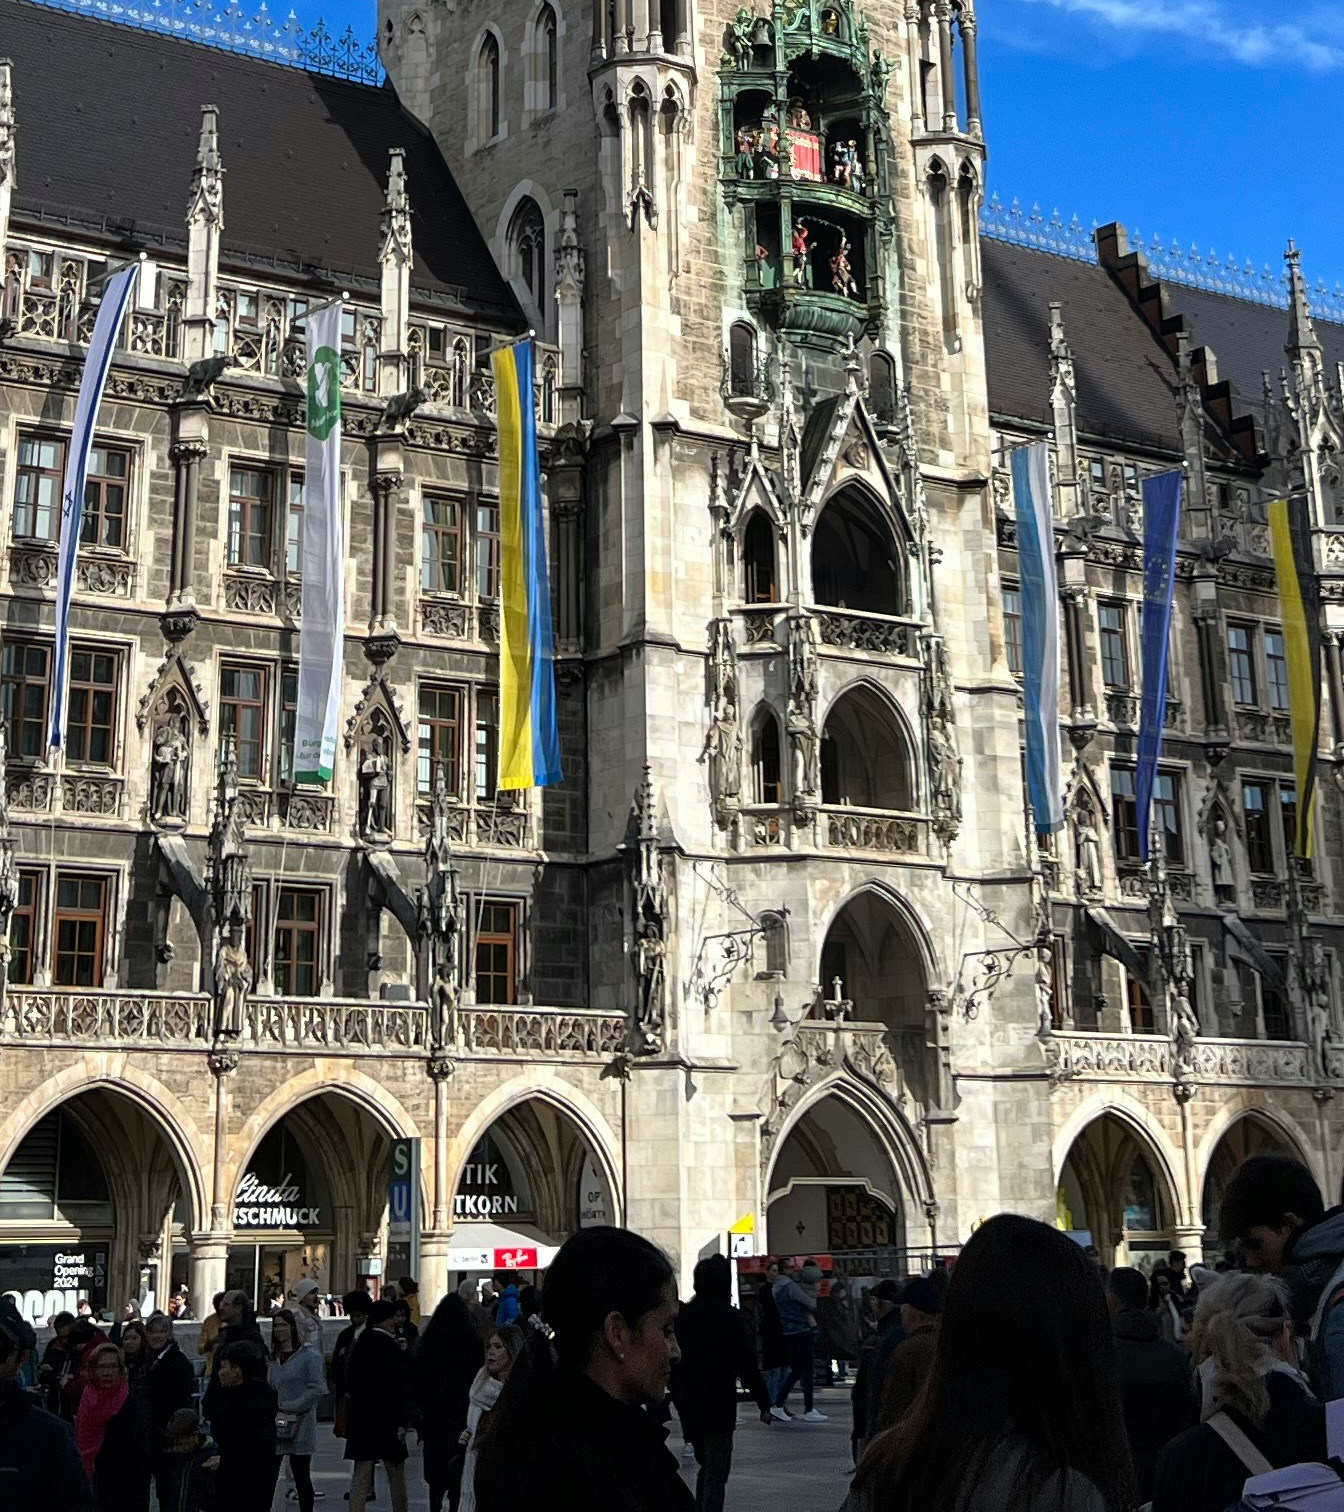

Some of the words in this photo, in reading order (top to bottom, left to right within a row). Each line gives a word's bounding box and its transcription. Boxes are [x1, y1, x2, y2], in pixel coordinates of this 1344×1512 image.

[394, 1143, 409, 1176] S
[465, 1163, 498, 1185] TIK
[235, 1171, 301, 1203] Linda
[394, 1185, 407, 1217] U
[54, 1253, 85, 1264] Grand
[53, 1265, 94, 1277] Opening
[53, 1277, 79, 1288] 2024
